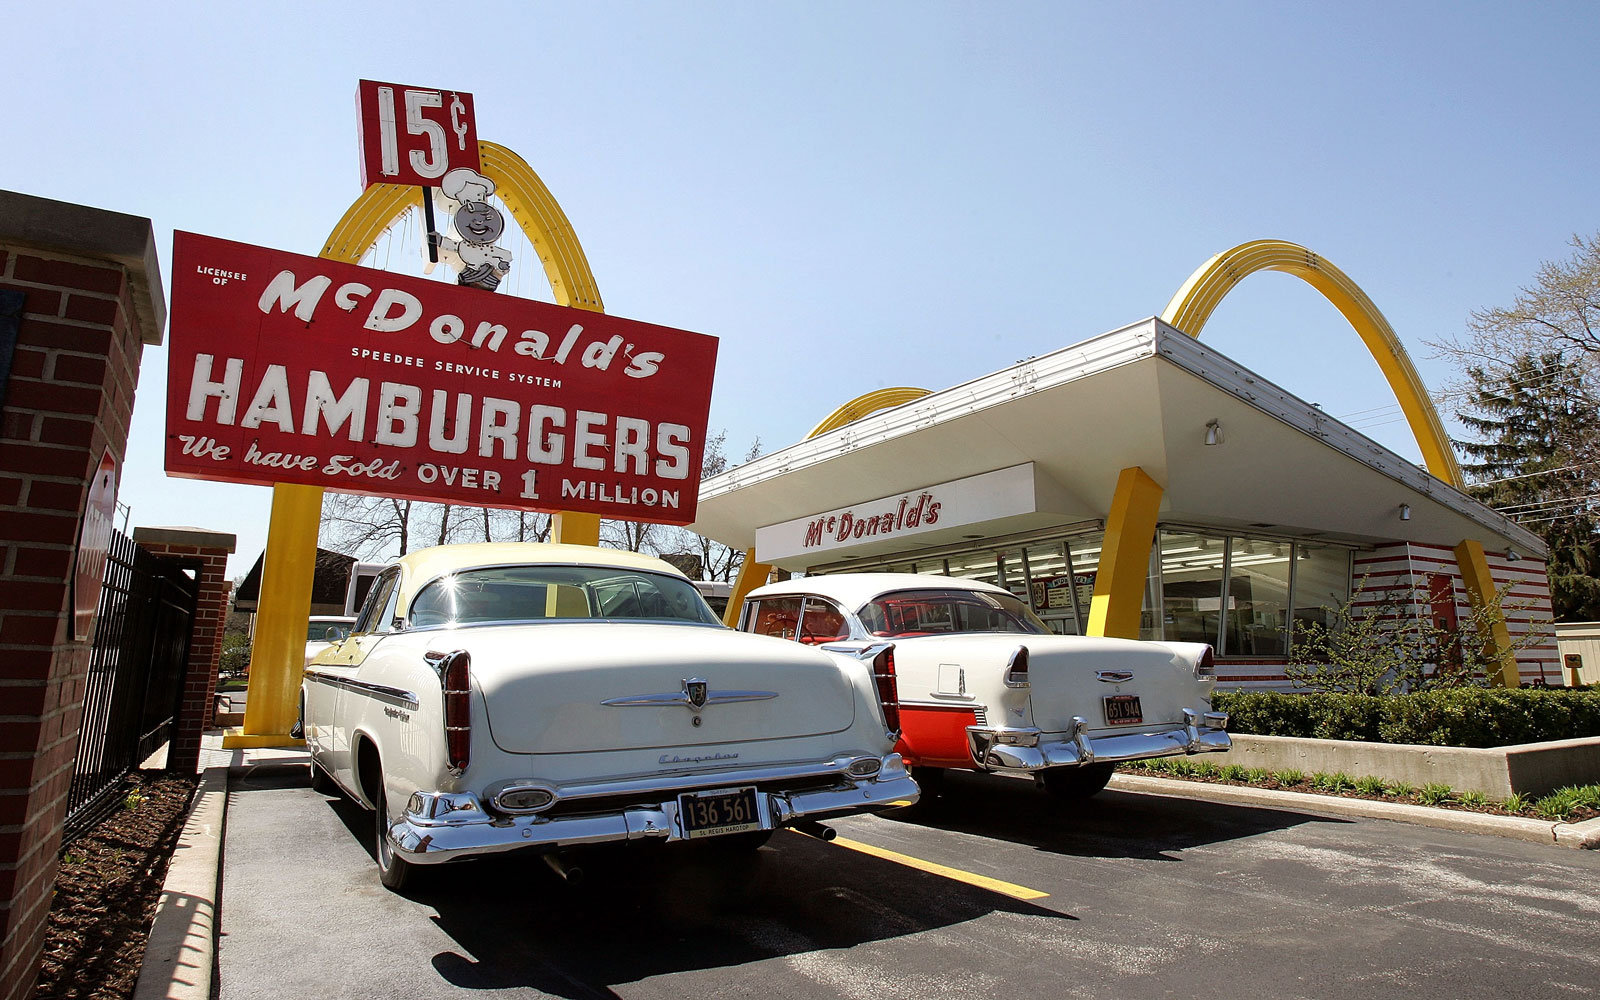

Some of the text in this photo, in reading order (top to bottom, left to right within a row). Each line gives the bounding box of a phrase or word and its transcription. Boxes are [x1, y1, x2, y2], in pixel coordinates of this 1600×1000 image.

[197, 265, 247, 281] LICENSEE
[212, 277, 228, 286] OF
[257, 270, 665, 378] McDonald's
[351, 347, 562, 388] SPEEDEE SERVICE SYSTEM
[186, 352, 692, 480] HAMBURGERS
[178, 434, 680, 509] We have Sold OVER 1 MILLION
[802, 491, 942, 548] McDonald's
[688, 796, 752, 827] 136 561
